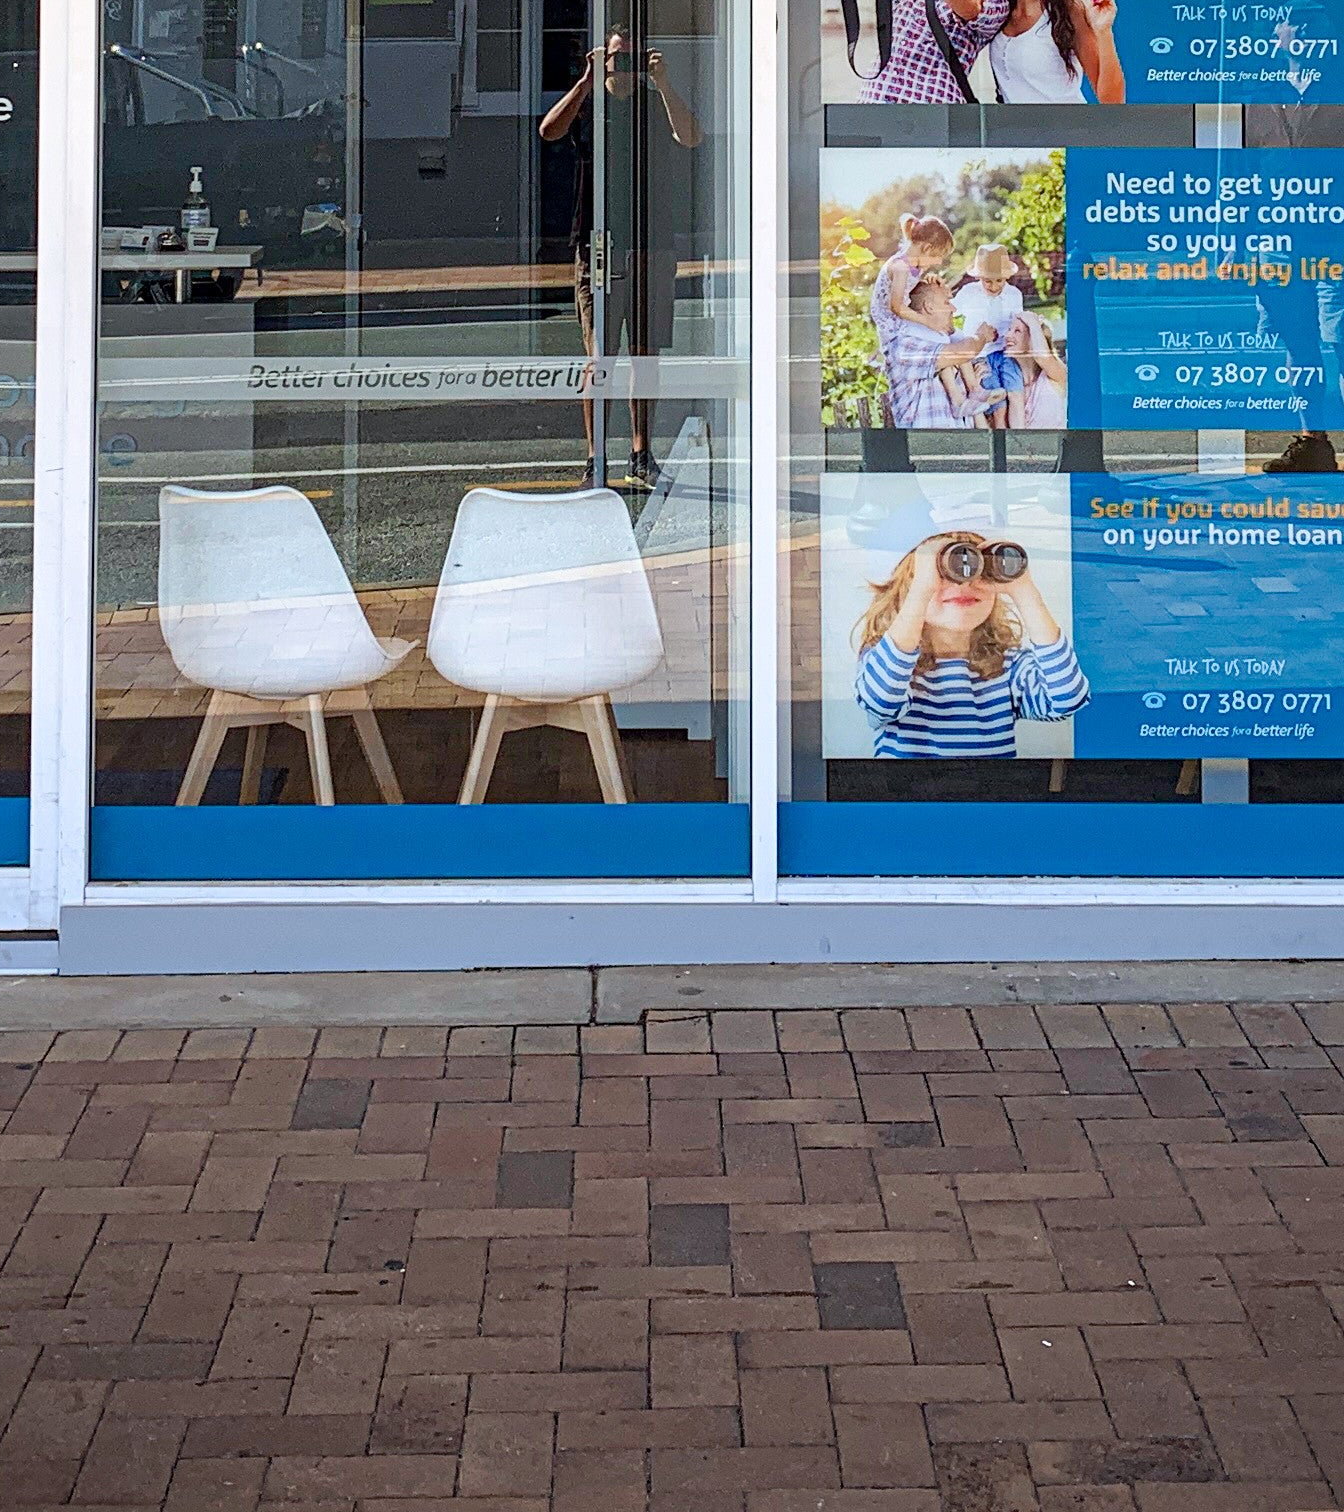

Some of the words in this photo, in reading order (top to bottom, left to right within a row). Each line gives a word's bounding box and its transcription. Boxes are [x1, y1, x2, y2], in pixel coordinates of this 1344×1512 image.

[1172, 5, 1205, 21] TALK
[1210, 4, 1227, 22] TO
[1233, 5, 1246, 22] US
[1252, 4, 1293, 22] TODAY
[1190, 39, 1217, 58] 07
[1224, 36, 1280, 60] 3807
[1288, 37, 1339, 59] 0771
[1147, 69, 1187, 81] Better
[1189, 69, 1236, 83] choices
[1259, 68, 1299, 83] better
[1301, 67, 1322, 84] life
[1107, 171, 1174, 194] Need
[1183, 174, 1210, 194] to
[1220, 174, 1262, 201] get
[1270, 178, 1333, 200] your
[1086, 200, 1160, 222] debts
[1170, 200, 1249, 223] under
[1148, 235, 1177, 251] so
[1186, 234, 1236, 259] you
[1245, 234, 1292, 253] can
[1084, 257, 1149, 280] relax
[1155, 257, 1208, 280] and
[1215, 258, 1291, 286] enjoy
[248, 364, 324, 389] Better
[333, 362, 430, 388] choices
[482, 362, 563, 388] better
[567, 361, 606, 393] life
[1091, 498, 1134, 518] See
[1142, 498, 1160, 518] if
[1166, 501, 1212, 524] you
[1220, 497, 1290, 518] could
[1104, 529, 1134, 544] on
[1143, 529, 1201, 550] your
[1209, 523, 1280, 545] home
[1288, 524, 1342, 545] loan
[1183, 694, 1210, 713] 07
[1219, 691, 1274, 713] 3807
[1283, 694, 1330, 713] 0771
